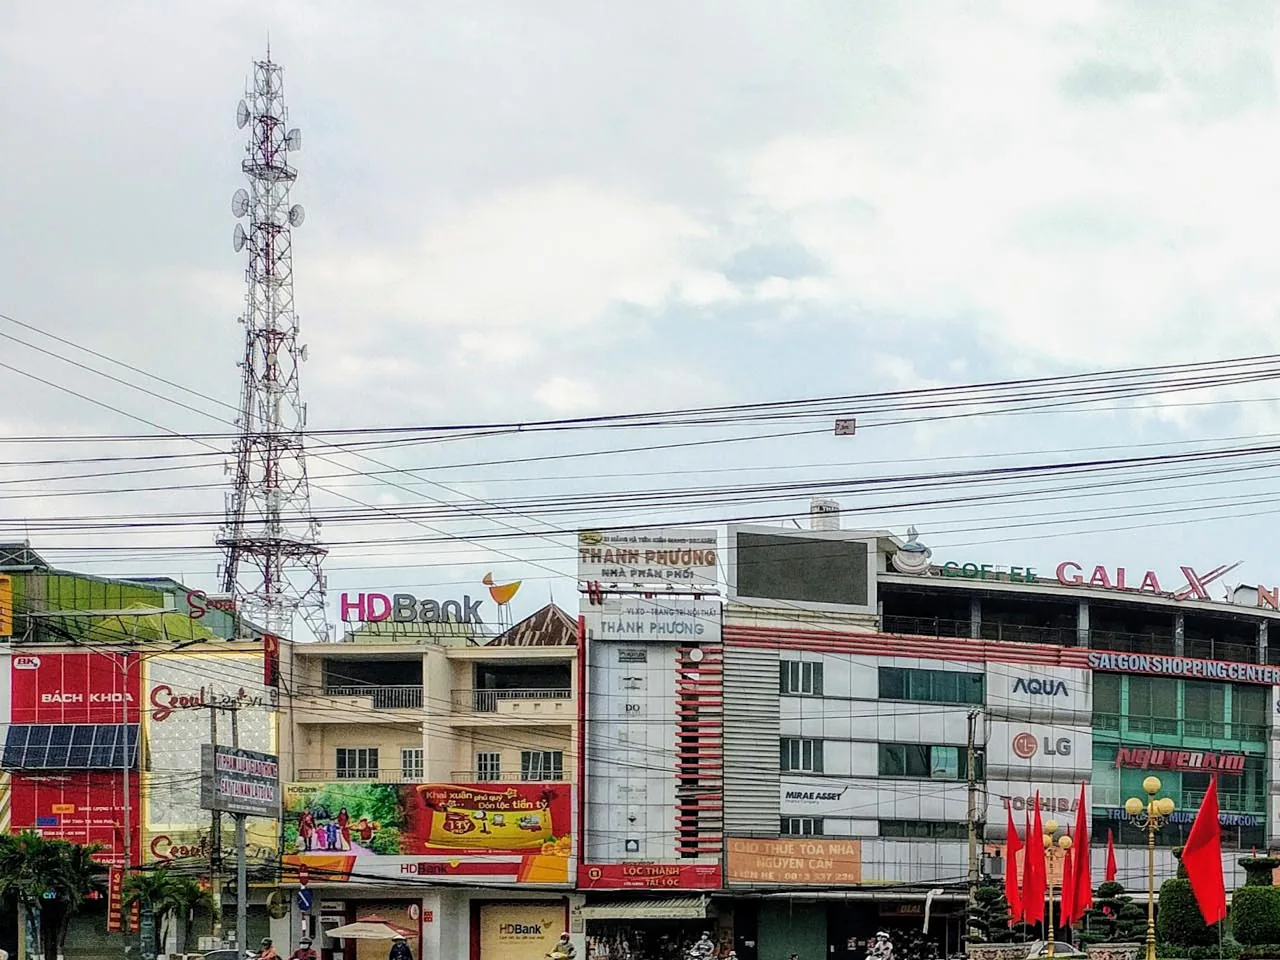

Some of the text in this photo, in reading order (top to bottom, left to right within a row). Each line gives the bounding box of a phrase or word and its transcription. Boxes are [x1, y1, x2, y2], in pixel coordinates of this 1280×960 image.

[186, 590, 237, 619] Seoul
[341, 593, 484, 623] HDBank
[1088, 653, 1280, 684] SAIGON SHOPPING CENTER
[41, 690, 134, 702] BÁCH KHOA
[1013, 678, 1069, 697] AQUA
[150, 684, 205, 721] Seoul
[1043, 736, 1072, 756] LG
[426, 791, 447, 799] Khai
[449, 790, 473, 800] xuân
[785, 791, 843, 800] MIRAE ASSET
[499, 924, 541, 934] HDBank
